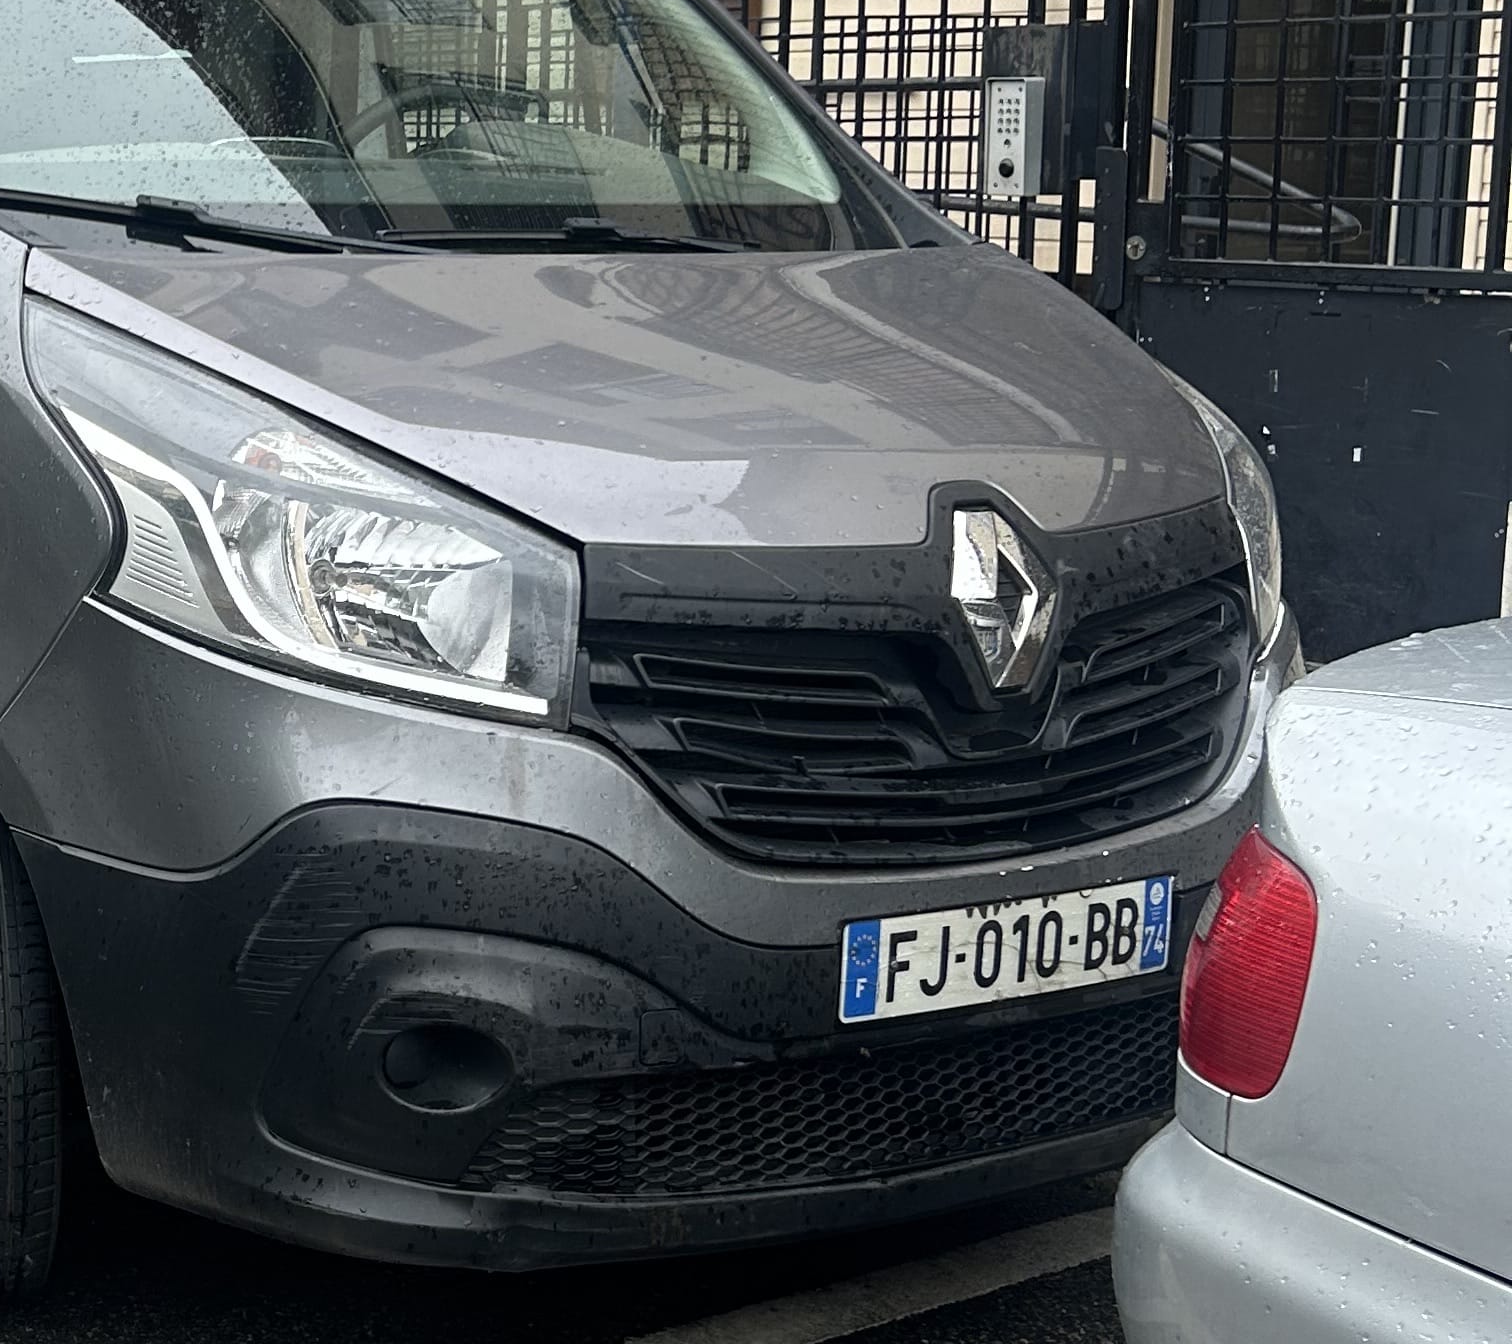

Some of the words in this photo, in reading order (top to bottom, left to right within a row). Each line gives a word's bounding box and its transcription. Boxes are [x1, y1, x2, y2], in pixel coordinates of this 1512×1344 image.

[885, 897, 1139, 1003] FJ-010-BB
[1142, 924, 1166, 957] 74
[854, 977, 868, 1000] F
